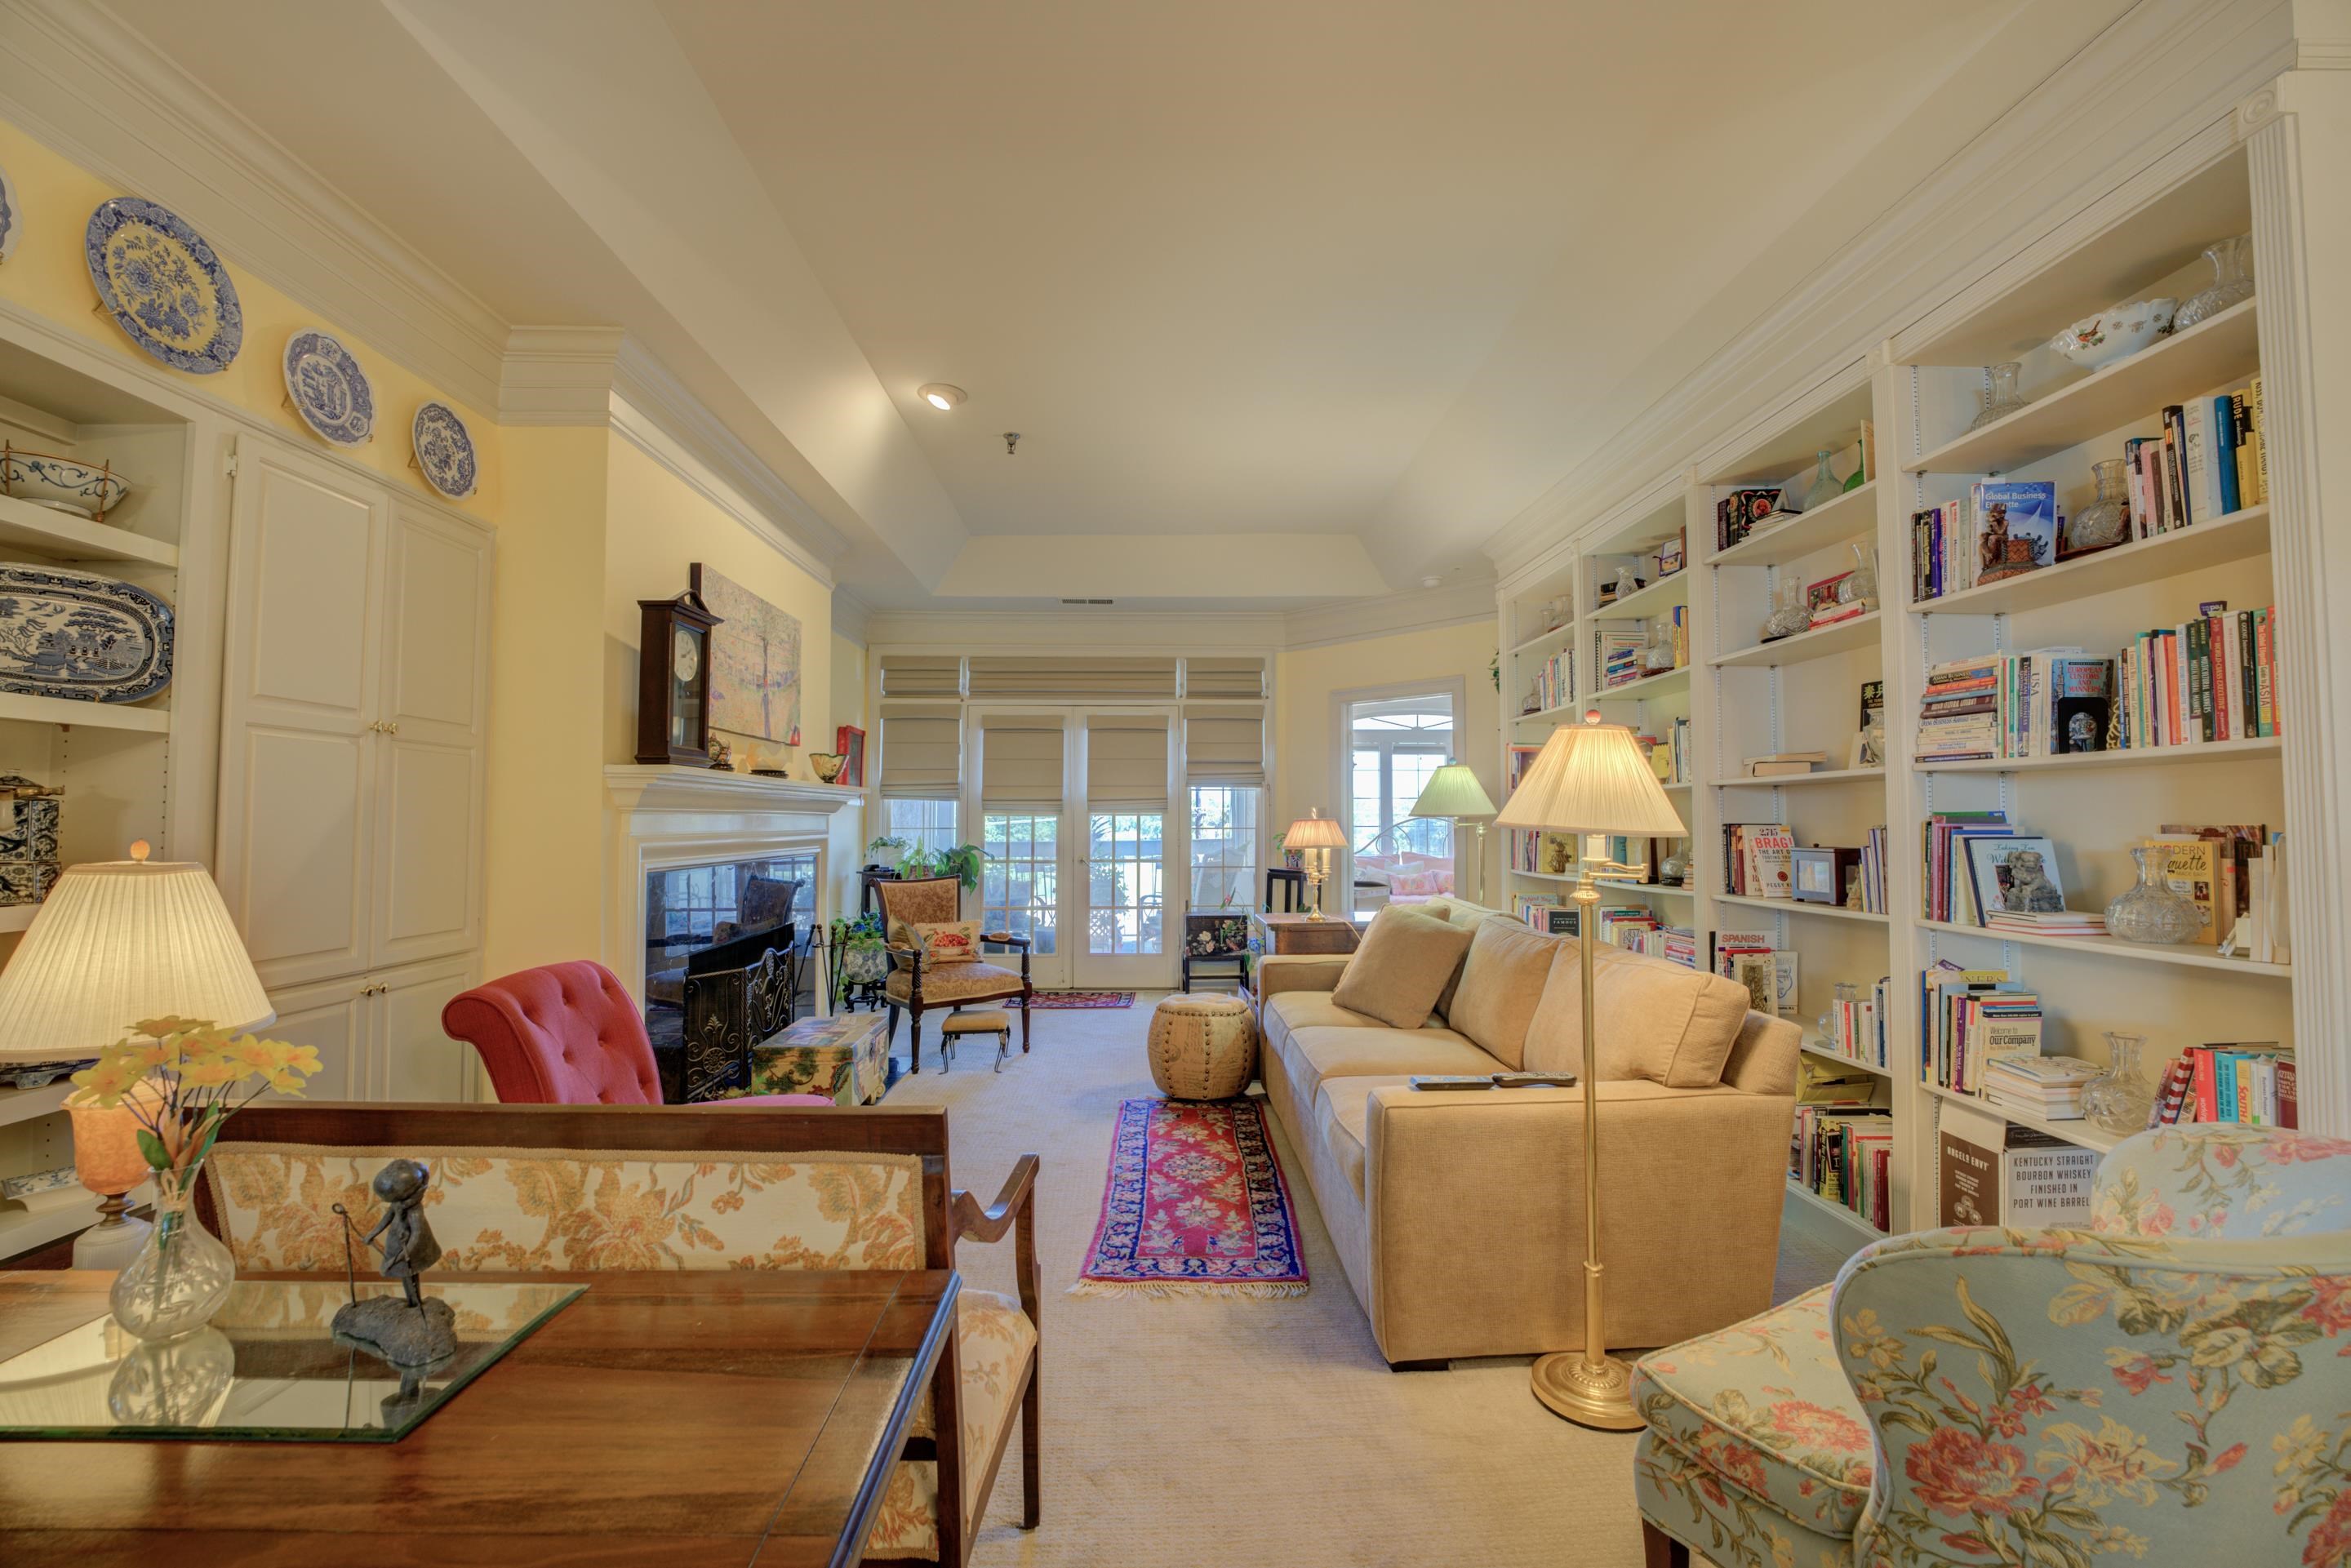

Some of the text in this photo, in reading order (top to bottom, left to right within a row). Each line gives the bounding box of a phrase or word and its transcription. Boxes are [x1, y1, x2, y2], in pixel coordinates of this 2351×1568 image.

[2233, 397, 2242, 419] RUDE
[1985, 491, 2046, 500] Global Business
[2257, 624, 2267, 633] The
[2258, 633, 2267, 646] Global
[2242, 639, 2250, 667] International
[2258, 647, 2268, 665] Etiquette
[2190, 660, 2200, 693] MULTICULTURAL
[2201, 656, 2209, 690] MULTICULTURAL
[2031, 673, 2040, 696] USA
[2202, 691, 2211, 713] MANNERS
[2216, 680, 2224, 709] EXECUTIVE
[2260, 685, 2270, 706] ASIA
[2193, 695, 2201, 716] MANNERS
[1755, 837, 1793, 849] BRAG!
[1722, 935, 1765, 943] SPANISH
[1989, 1026, 2011, 1034] Welcome
[1989, 1035, 2036, 1046] Our Company
[2239, 1085, 2248, 1117] SOUTH
[1971, 1156, 1989, 1171] ENVY
[2014, 1155, 2094, 1167] KENTUCKY STRAIGHT
[2016, 1169, 2091, 1181] BOURBON WHISKEY
[2031, 1184, 2077, 1194] FINISHED IN
[2014, 1197, 2090, 1208] PORT WINE BARREL
